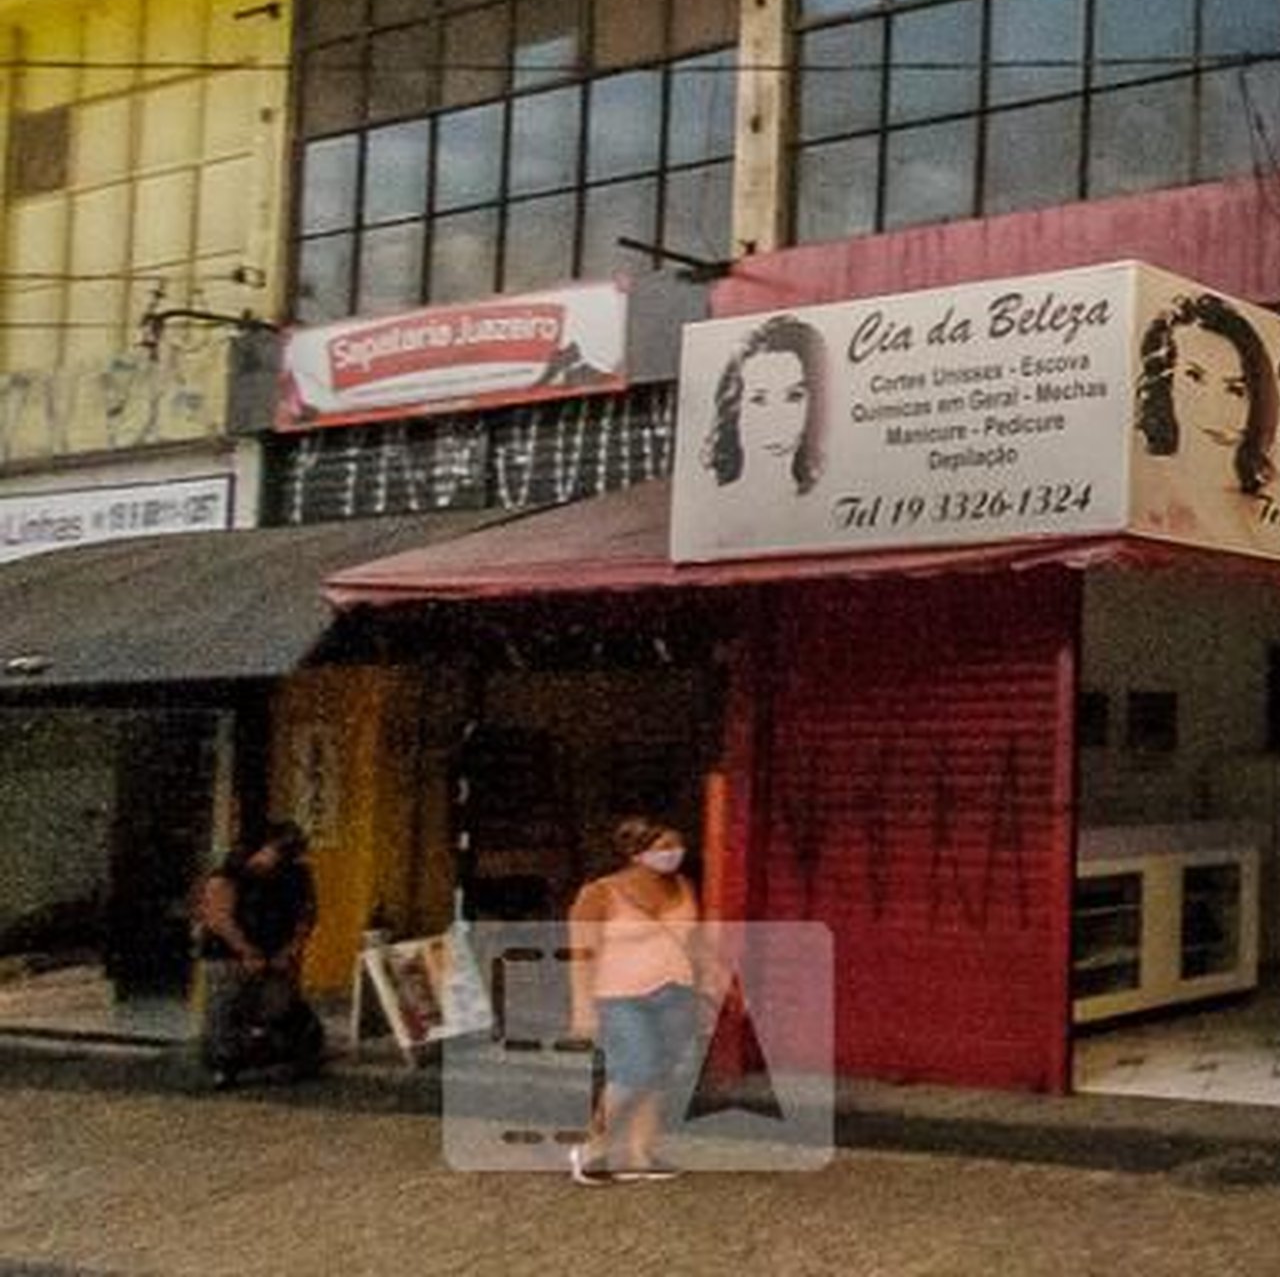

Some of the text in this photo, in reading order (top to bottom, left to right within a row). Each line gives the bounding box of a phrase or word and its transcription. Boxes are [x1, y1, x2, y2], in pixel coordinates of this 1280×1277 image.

[848, 292, 1111, 364] Cia da Beleza
[870, 375, 926, 393] Cortes
[1021, 354, 1091, 376] Escova
[937, 397, 965, 413] em
[969, 388, 1019, 411] Geral
[1036, 381, 1108, 403] Mechas
[886, 414, 1065, 445] Manicure Pedicure
[929, 447, 1019, 471] Depilação
[836, 483, 1093, 527] Tel 19 3326-1324
